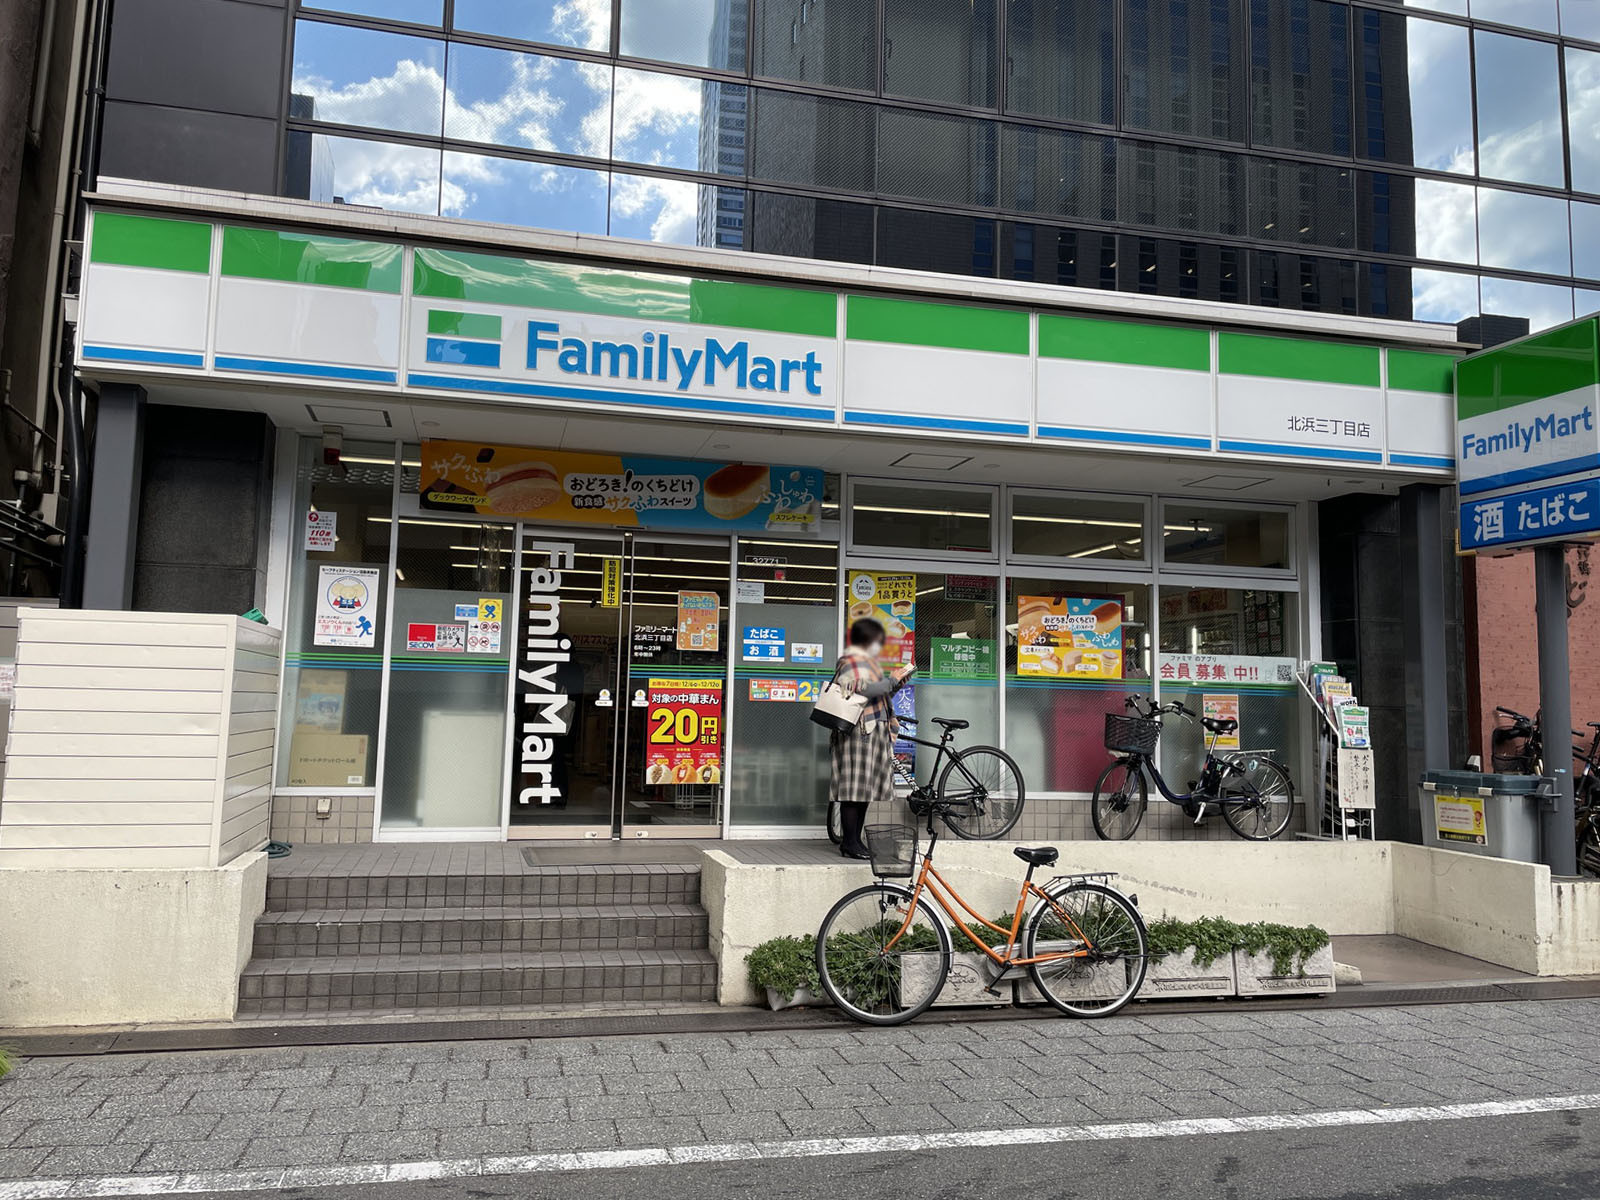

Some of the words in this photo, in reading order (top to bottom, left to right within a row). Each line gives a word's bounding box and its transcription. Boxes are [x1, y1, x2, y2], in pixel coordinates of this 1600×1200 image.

[525, 320, 822, 395] FamilyMart
[1287, 415, 1371, 438] 北浜三丁目店
[1462, 406, 1593, 459] FamilyMart
[1473, 501, 1505, 542] 酒
[1517, 491, 1590, 531] たばこ
[888, 581, 913, 589] どれでも
[634, 625, 678, 634] ファミリーマート
[749, 628, 779, 639] たばこ
[408, 641, 434, 649] SECOM
[634, 634, 673, 642] 北浜三丁目店
[518, 541, 575, 804] FamilyMart
[651, 693, 720, 705] 対象の中華まん
[650, 707, 699, 744] 20
[701, 716, 718, 736] 円
[700, 735, 718, 745] 引き
